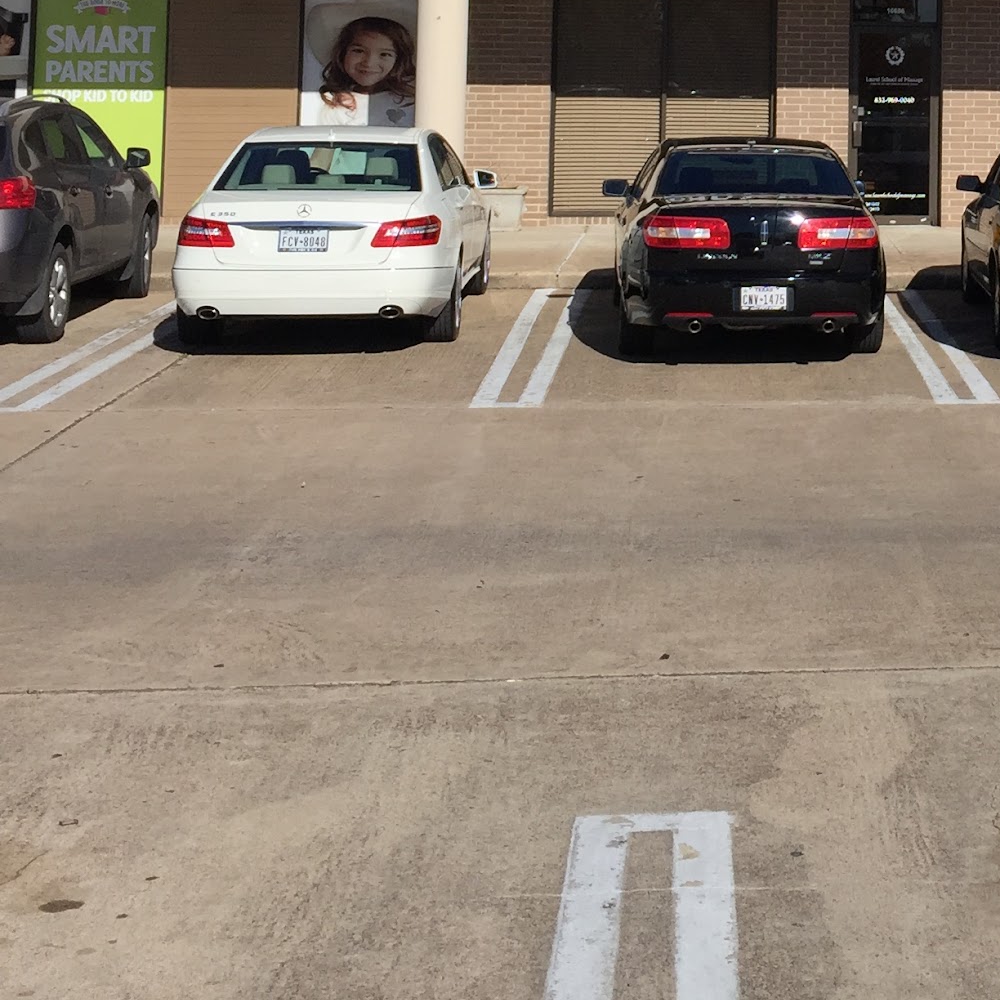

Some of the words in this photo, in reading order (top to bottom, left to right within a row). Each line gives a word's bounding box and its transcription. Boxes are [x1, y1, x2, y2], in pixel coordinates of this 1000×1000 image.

[46, 25, 156, 54] SMART
[45, 60, 154, 83] PARENTS
[83, 89, 107, 102] KID
[110, 90, 127, 102] TO
[130, 90, 154, 103] KID
